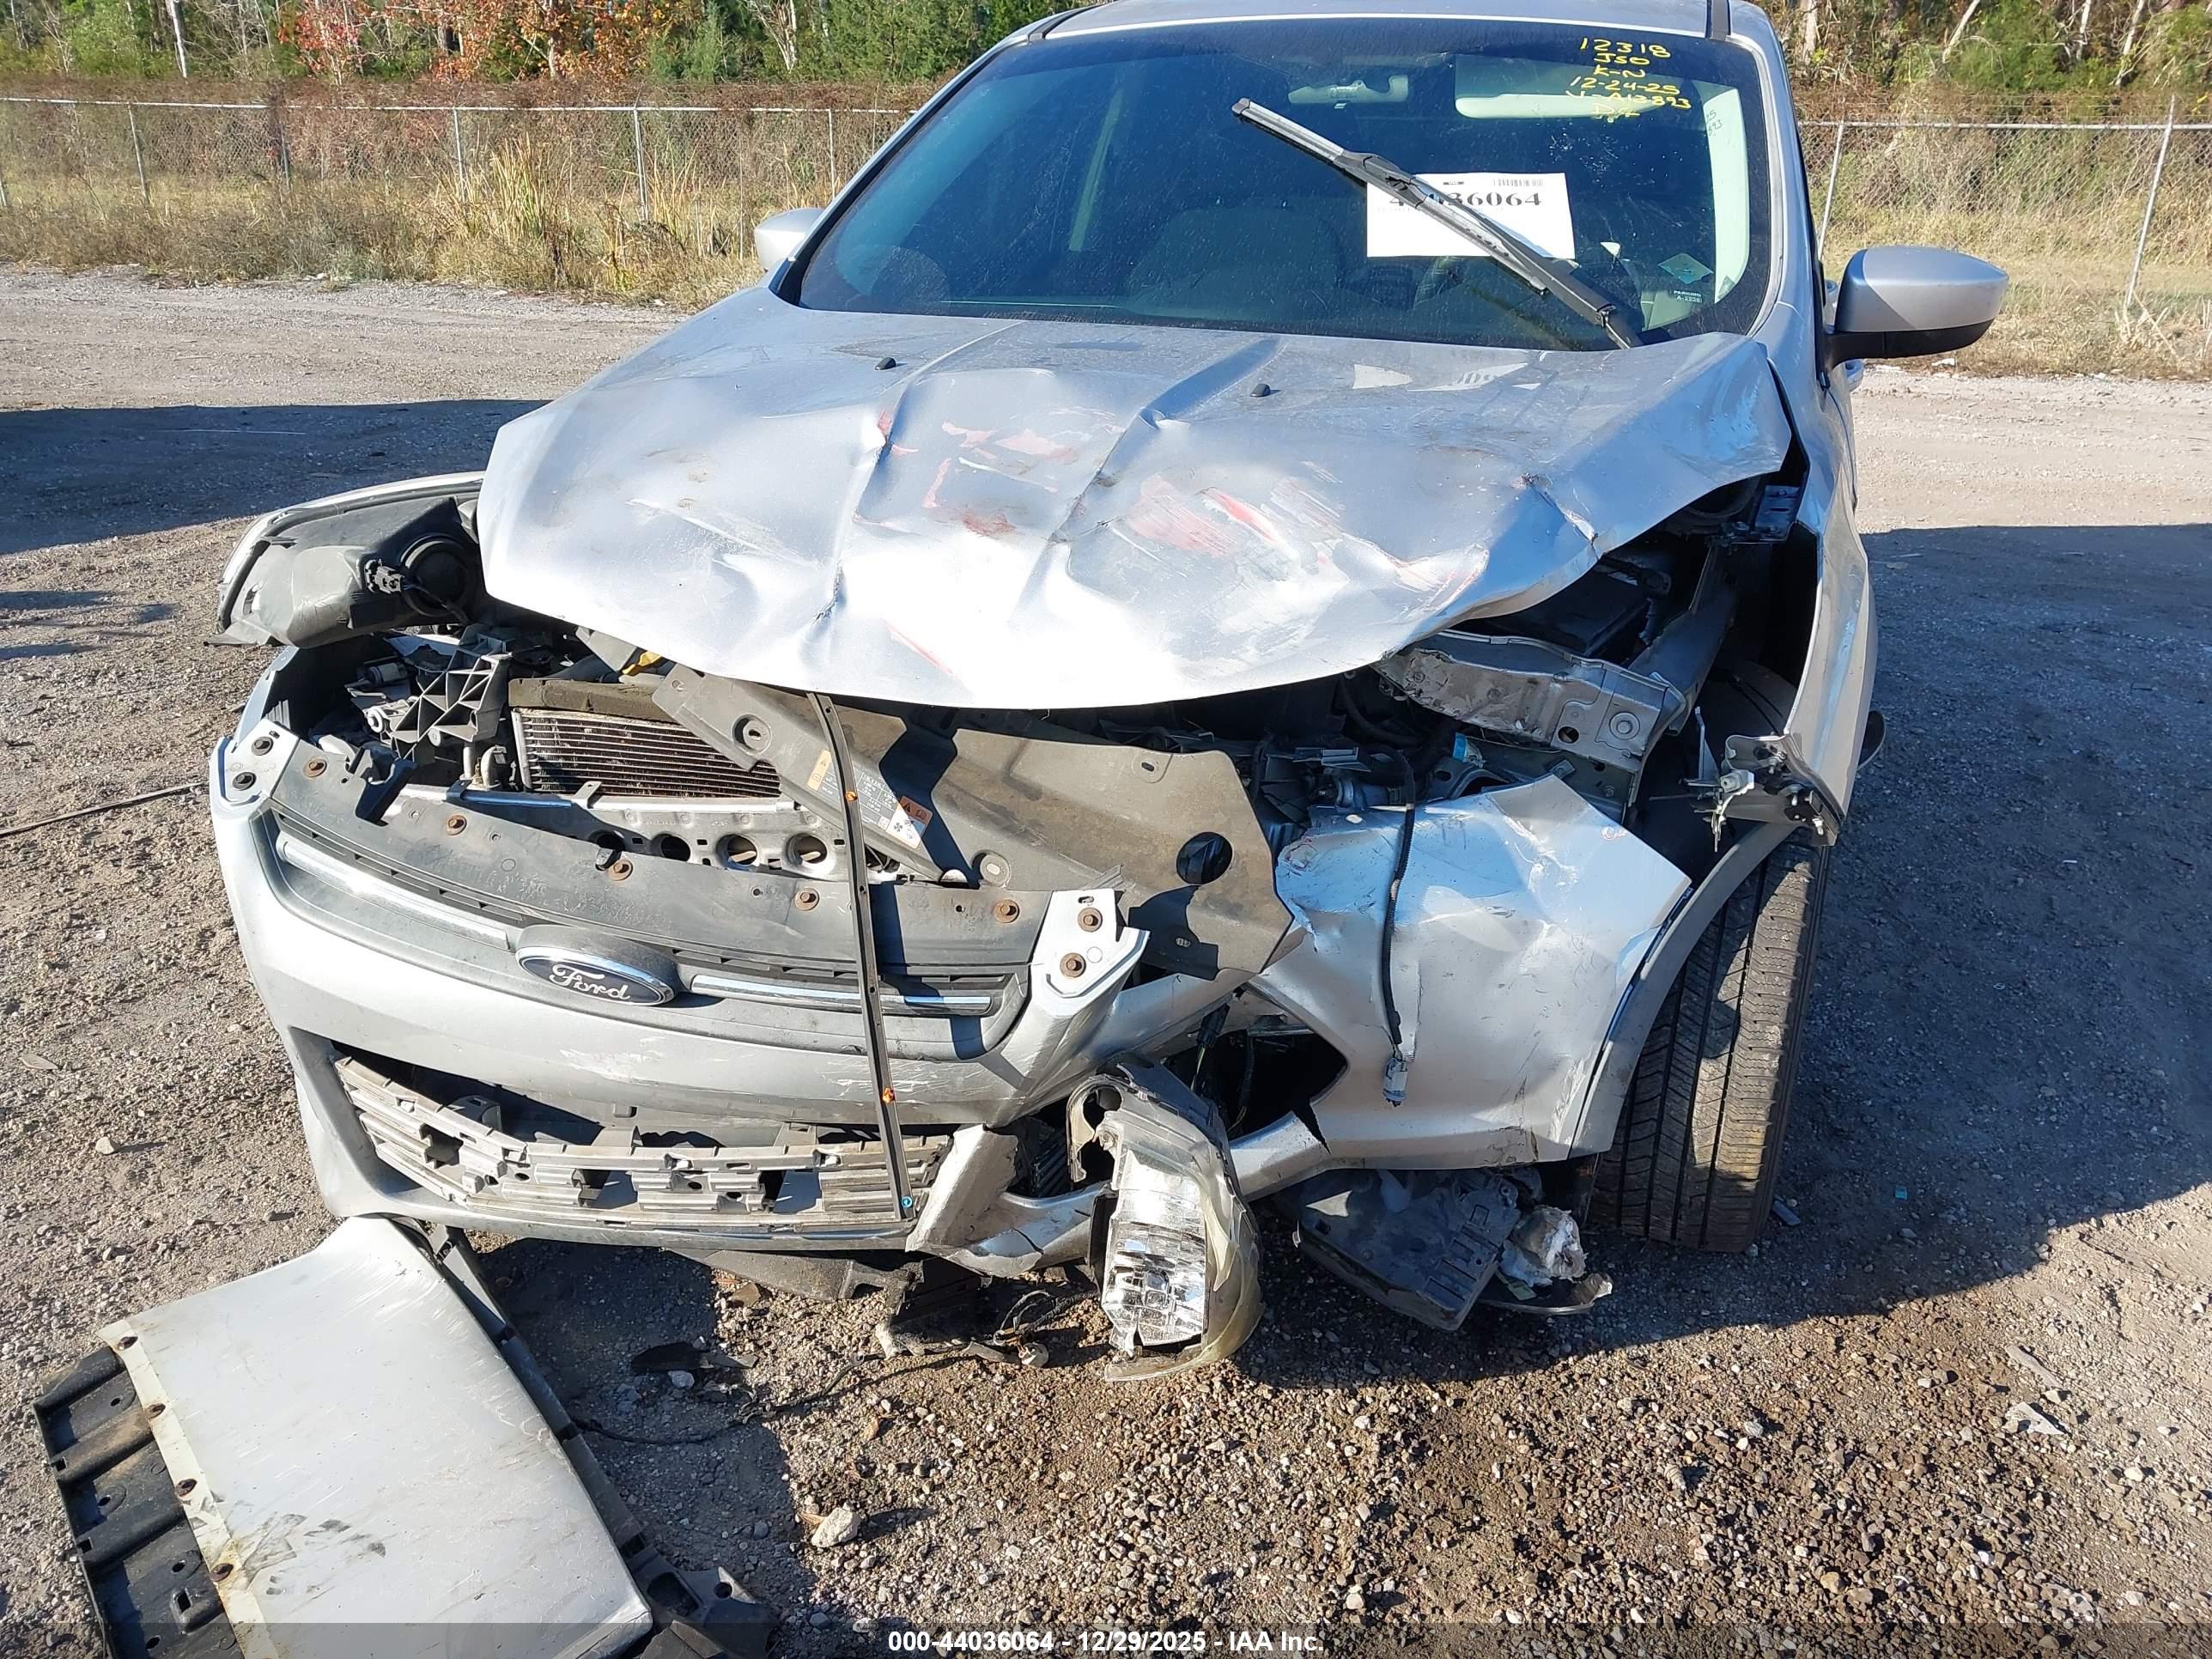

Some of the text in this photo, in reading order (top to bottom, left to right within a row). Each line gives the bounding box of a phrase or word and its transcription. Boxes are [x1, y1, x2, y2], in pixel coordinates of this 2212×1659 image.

[1580, 38, 1671, 58] 12318
[1570, 76, 1680, 95] 12-24-25
[1389, 191, 1542, 206] 436064
[549, 963, 631, 1000] Ford
